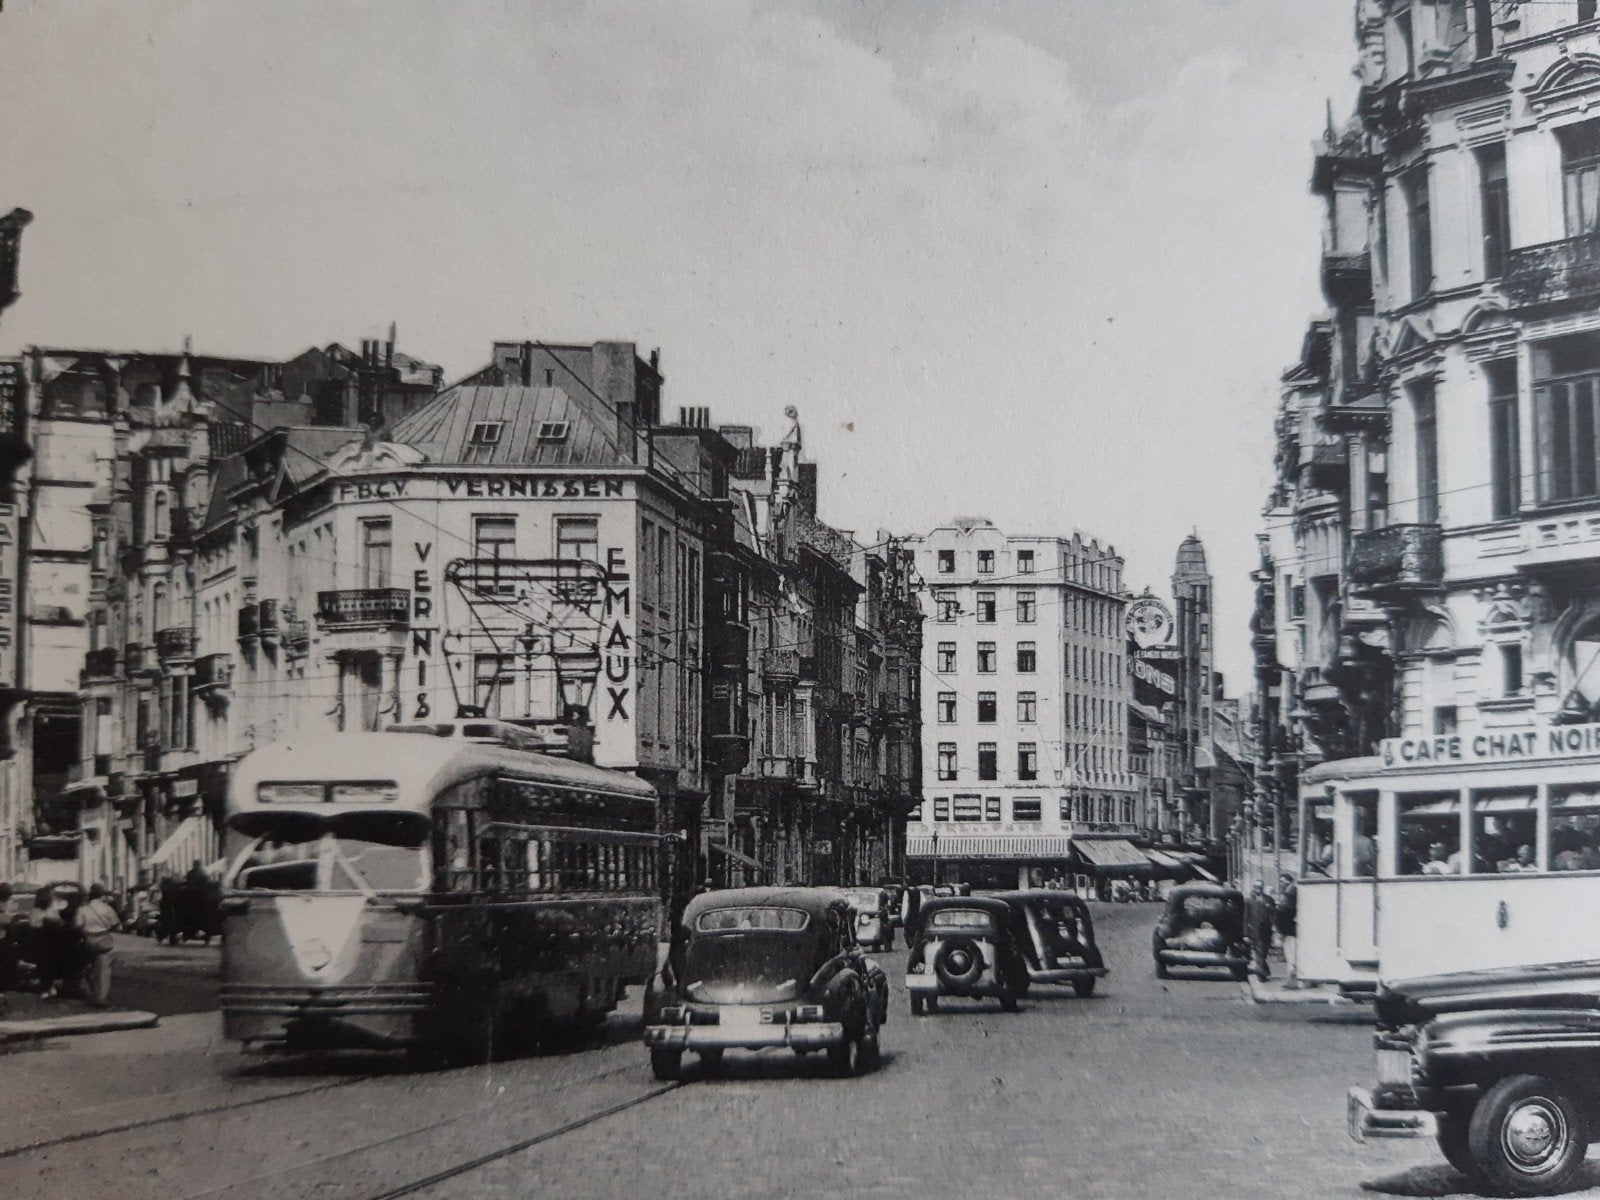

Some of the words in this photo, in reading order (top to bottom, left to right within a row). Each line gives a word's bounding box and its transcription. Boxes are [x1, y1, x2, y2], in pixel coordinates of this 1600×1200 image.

[447, 477, 624, 498] VERNISSEN
[413, 542, 433, 720] VERNIS
[605, 548, 631, 720] EMAUX
[1472, 732, 1537, 757] CHAT
